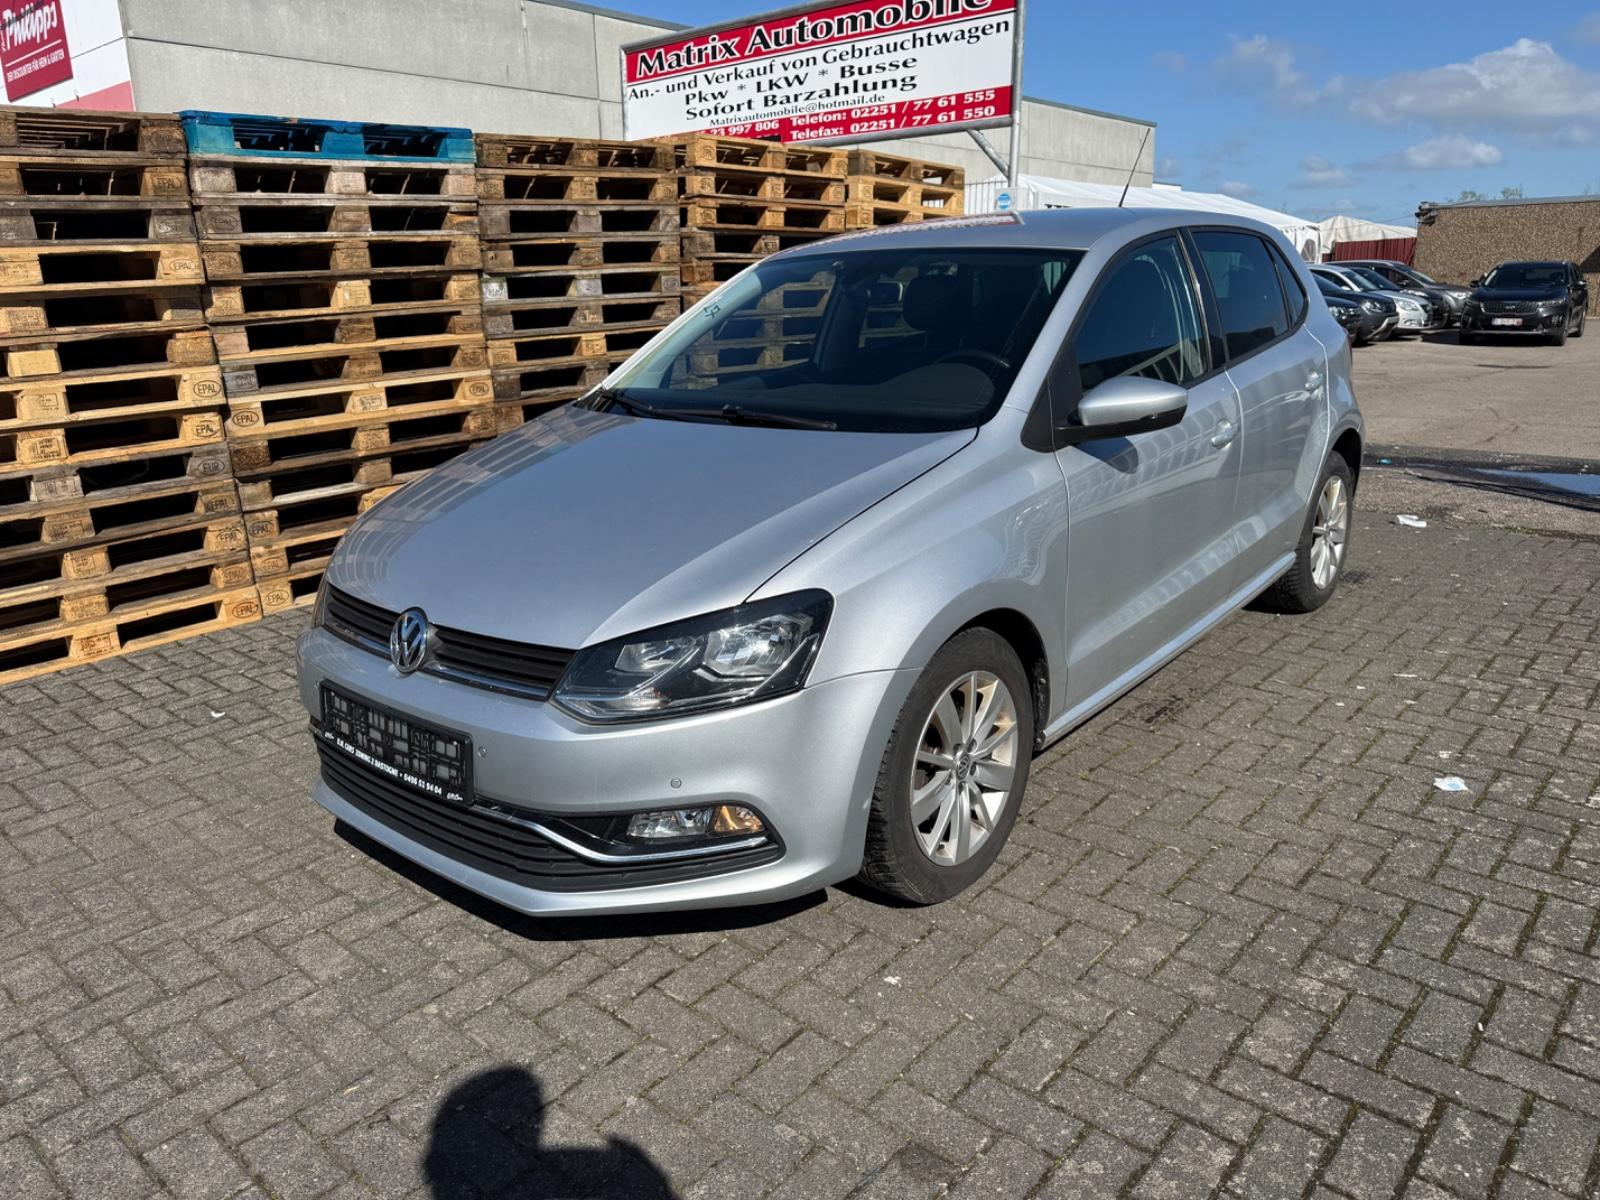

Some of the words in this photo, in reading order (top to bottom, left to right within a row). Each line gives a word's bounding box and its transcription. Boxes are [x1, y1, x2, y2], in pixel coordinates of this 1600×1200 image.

[638, 36, 740, 76] Matrix
[667, 76, 697, 94] und
[704, 60, 776, 85] Verkauf
[782, 57, 817, 72] von
[823, 20, 1009, 64] Gebrauchtwagen
[685, 90, 728, 105] Pkw
[756, 73, 808, 93] LKW
[840, 57, 918, 78] Busse
[686, 99, 754, 120] Sofort
[764, 75, 918, 107] Barzahlung
[709, 94, 885, 127] Matrixautomobile@hotmail.de
[790, 112, 847, 126] Telefon:
[851, 105, 897, 118] 02251
[913, 100, 931, 111] 77
[938, 95, 956, 106] 61
[964, 90, 995, 103] 555
[728, 124, 752, 135] 997
[755, 120, 779, 131] 806
[790, 127, 844, 140] Telefax:
[850, 120, 895, 133] 02251
[912, 114, 931, 125] 77
[938, 110, 956, 122] 61
[963, 105, 995, 119] 550
[197, 384, 217, 394] EPAL
[235, 413, 253, 423] EPAL
[195, 424, 214, 434] EPAL
[202, 462, 220, 472] EUR
[251, 523, 271, 533] EPAL
[267, 593, 284, 603] EPAL
[235, 605, 253, 615] EPAL
